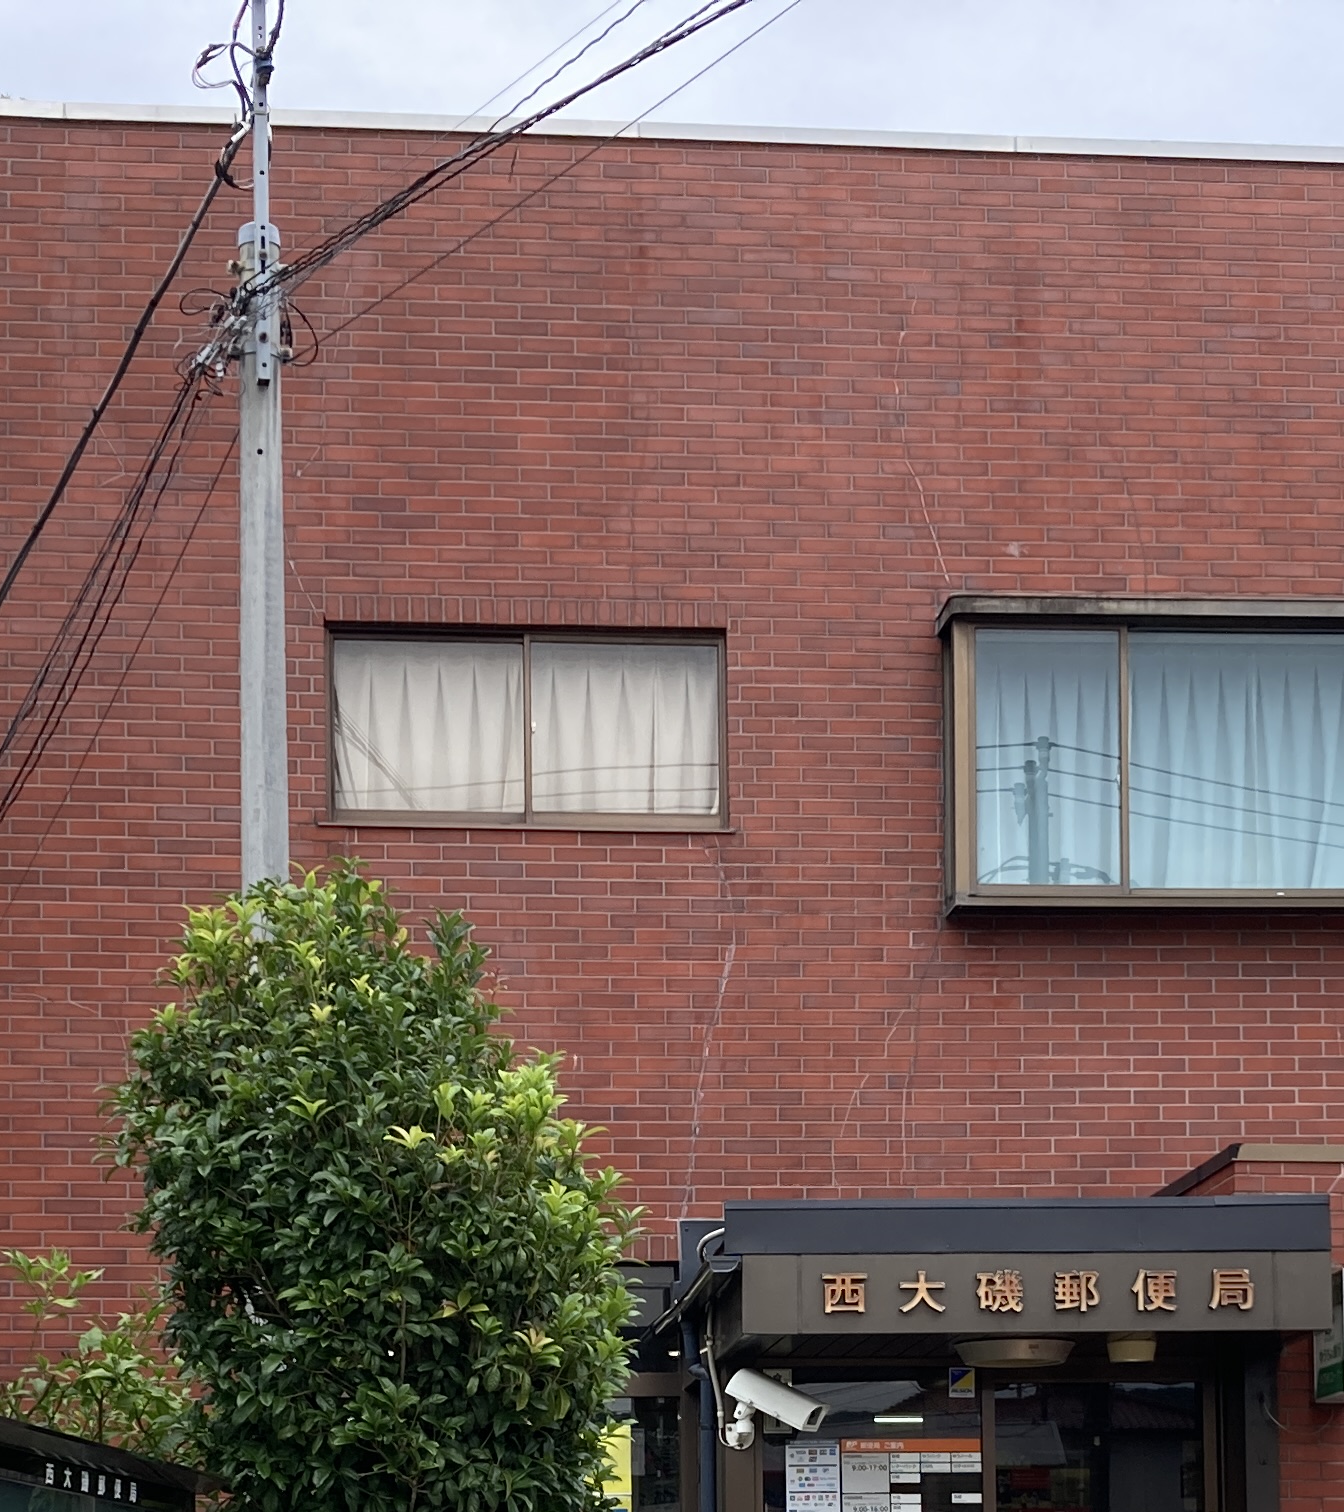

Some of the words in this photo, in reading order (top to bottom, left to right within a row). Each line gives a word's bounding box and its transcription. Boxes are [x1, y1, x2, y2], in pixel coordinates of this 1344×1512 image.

[821, 1267, 1256, 1315] 西大磯郵便局
